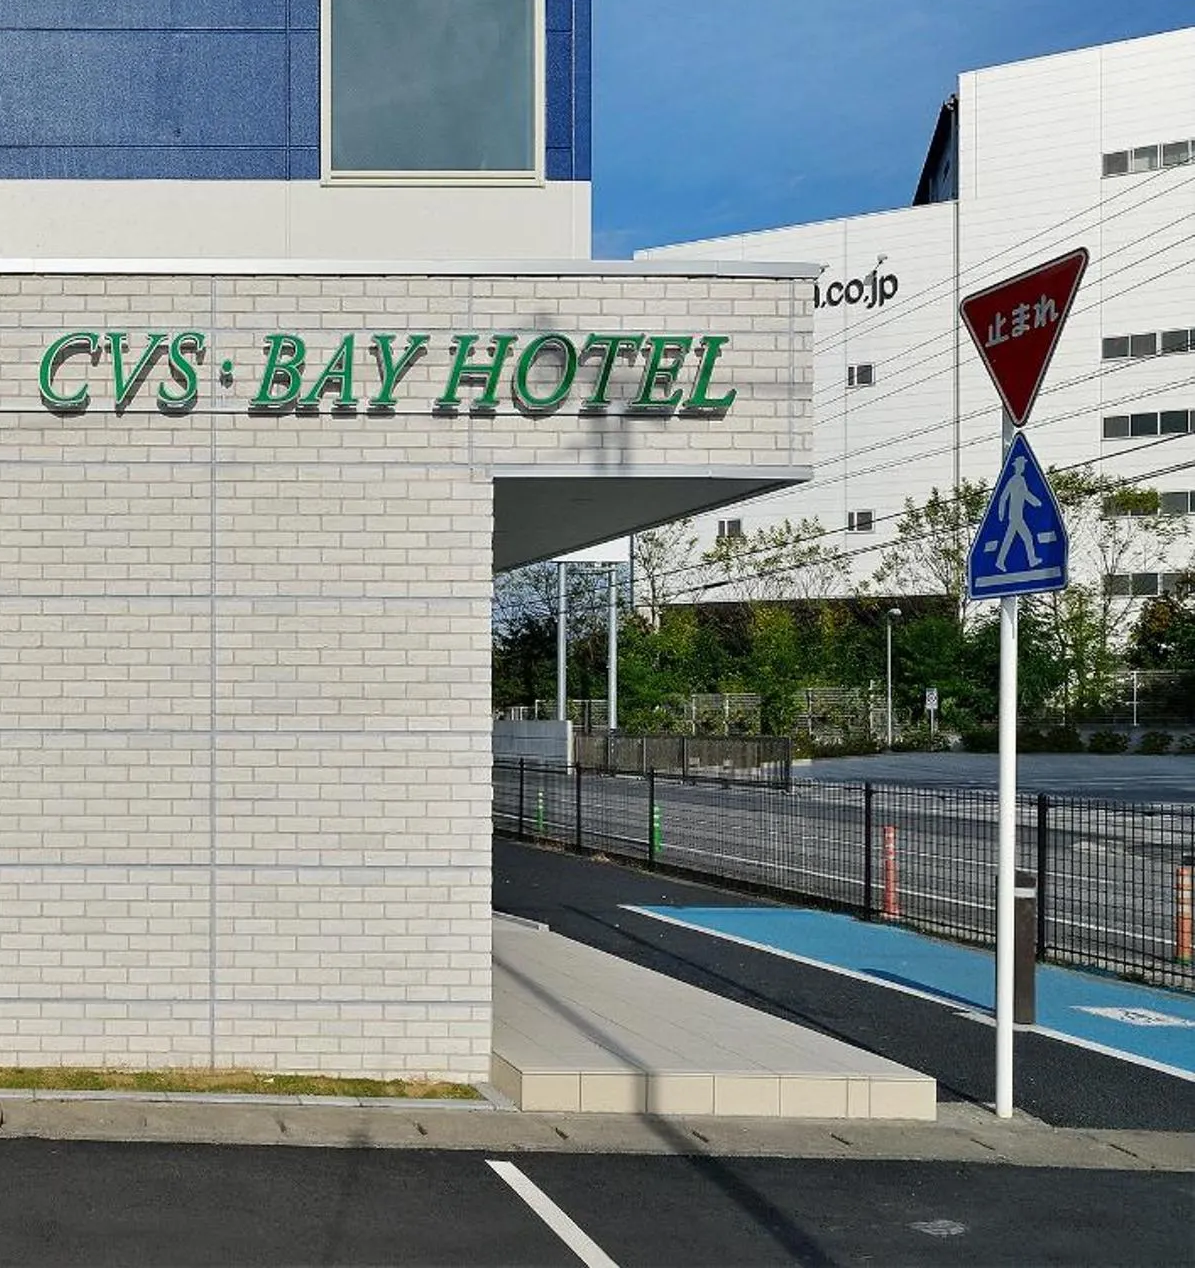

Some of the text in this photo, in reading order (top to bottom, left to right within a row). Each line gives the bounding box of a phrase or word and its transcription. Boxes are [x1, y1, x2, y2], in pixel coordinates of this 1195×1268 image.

[985, 293, 1059, 348] 止まれ
[249, 332, 431, 406] BAY
[435, 333, 737, 409] HOTEL
